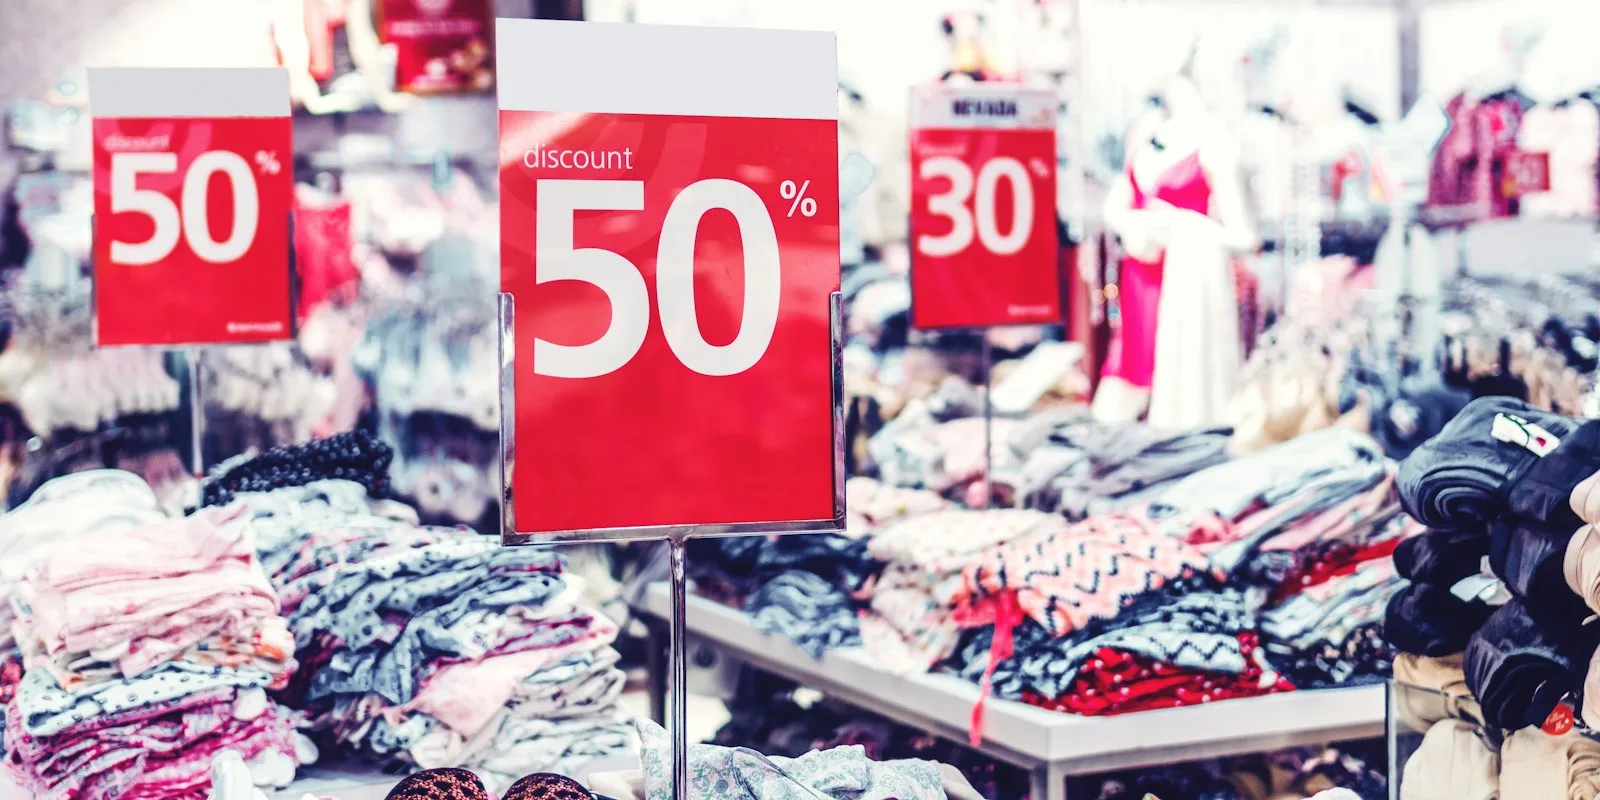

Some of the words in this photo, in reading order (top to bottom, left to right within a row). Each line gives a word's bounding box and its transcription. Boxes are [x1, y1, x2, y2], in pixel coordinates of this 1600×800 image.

[109, 150, 259, 265] 50
[523, 144, 633, 170] discount
[917, 156, 1035, 257] 30
[534, 178, 781, 378] 50
[779, 180, 818, 218] %
